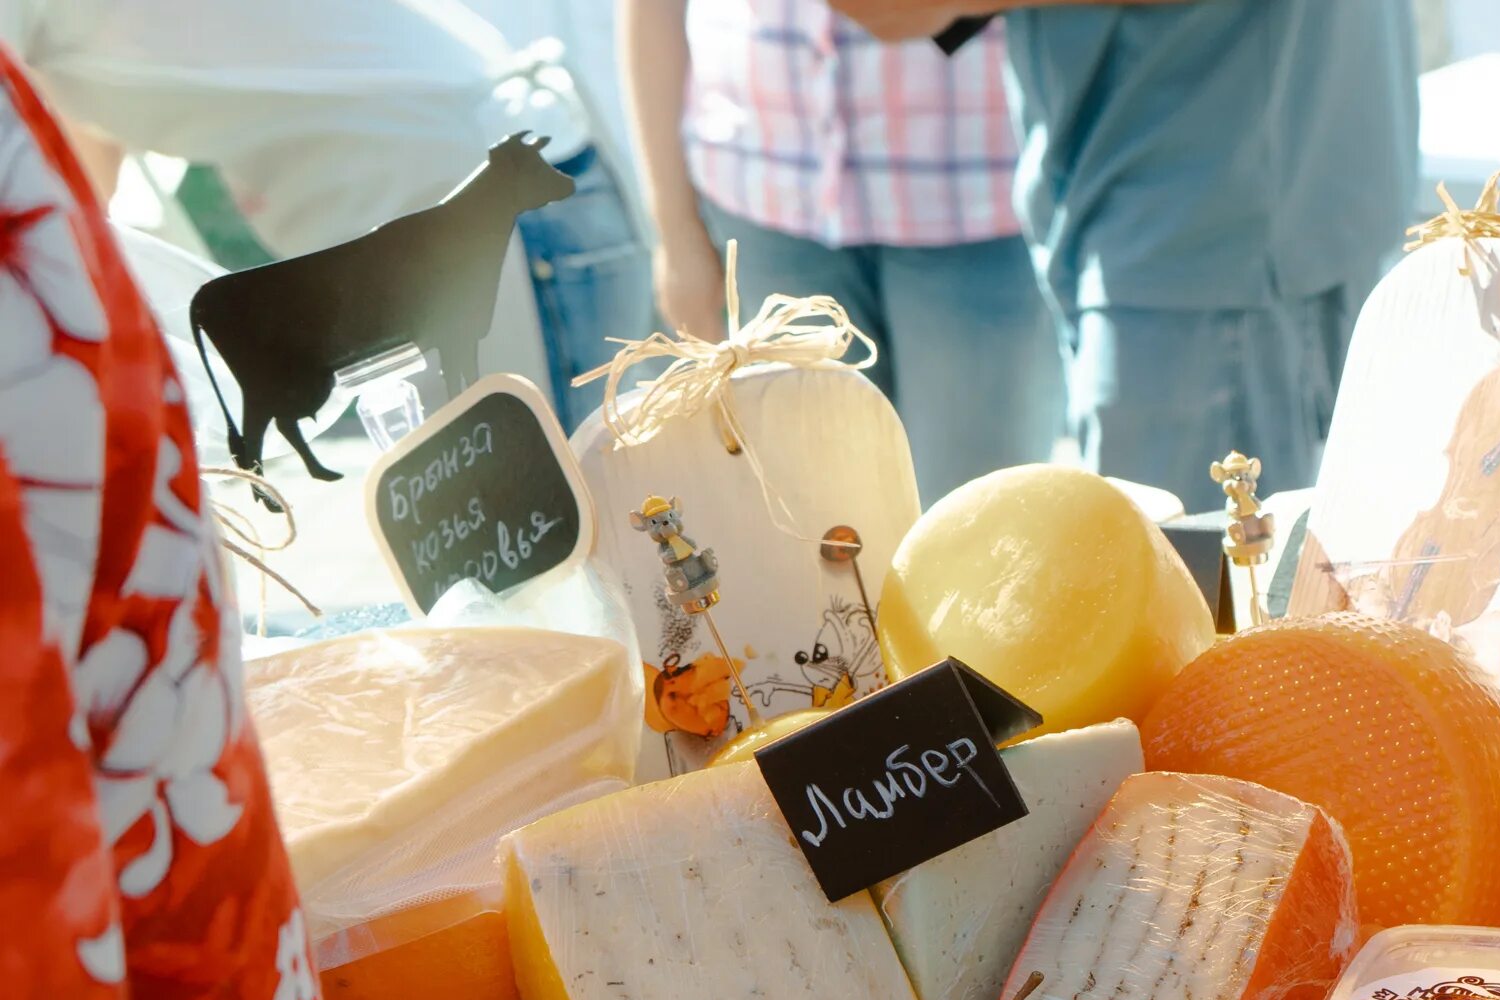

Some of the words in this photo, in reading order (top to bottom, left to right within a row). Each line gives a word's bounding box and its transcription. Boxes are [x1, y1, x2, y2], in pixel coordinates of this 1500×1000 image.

[388, 422, 493, 524] Брынза
[411, 497, 486, 574] козья
[802, 737, 1001, 848] Ламбер
